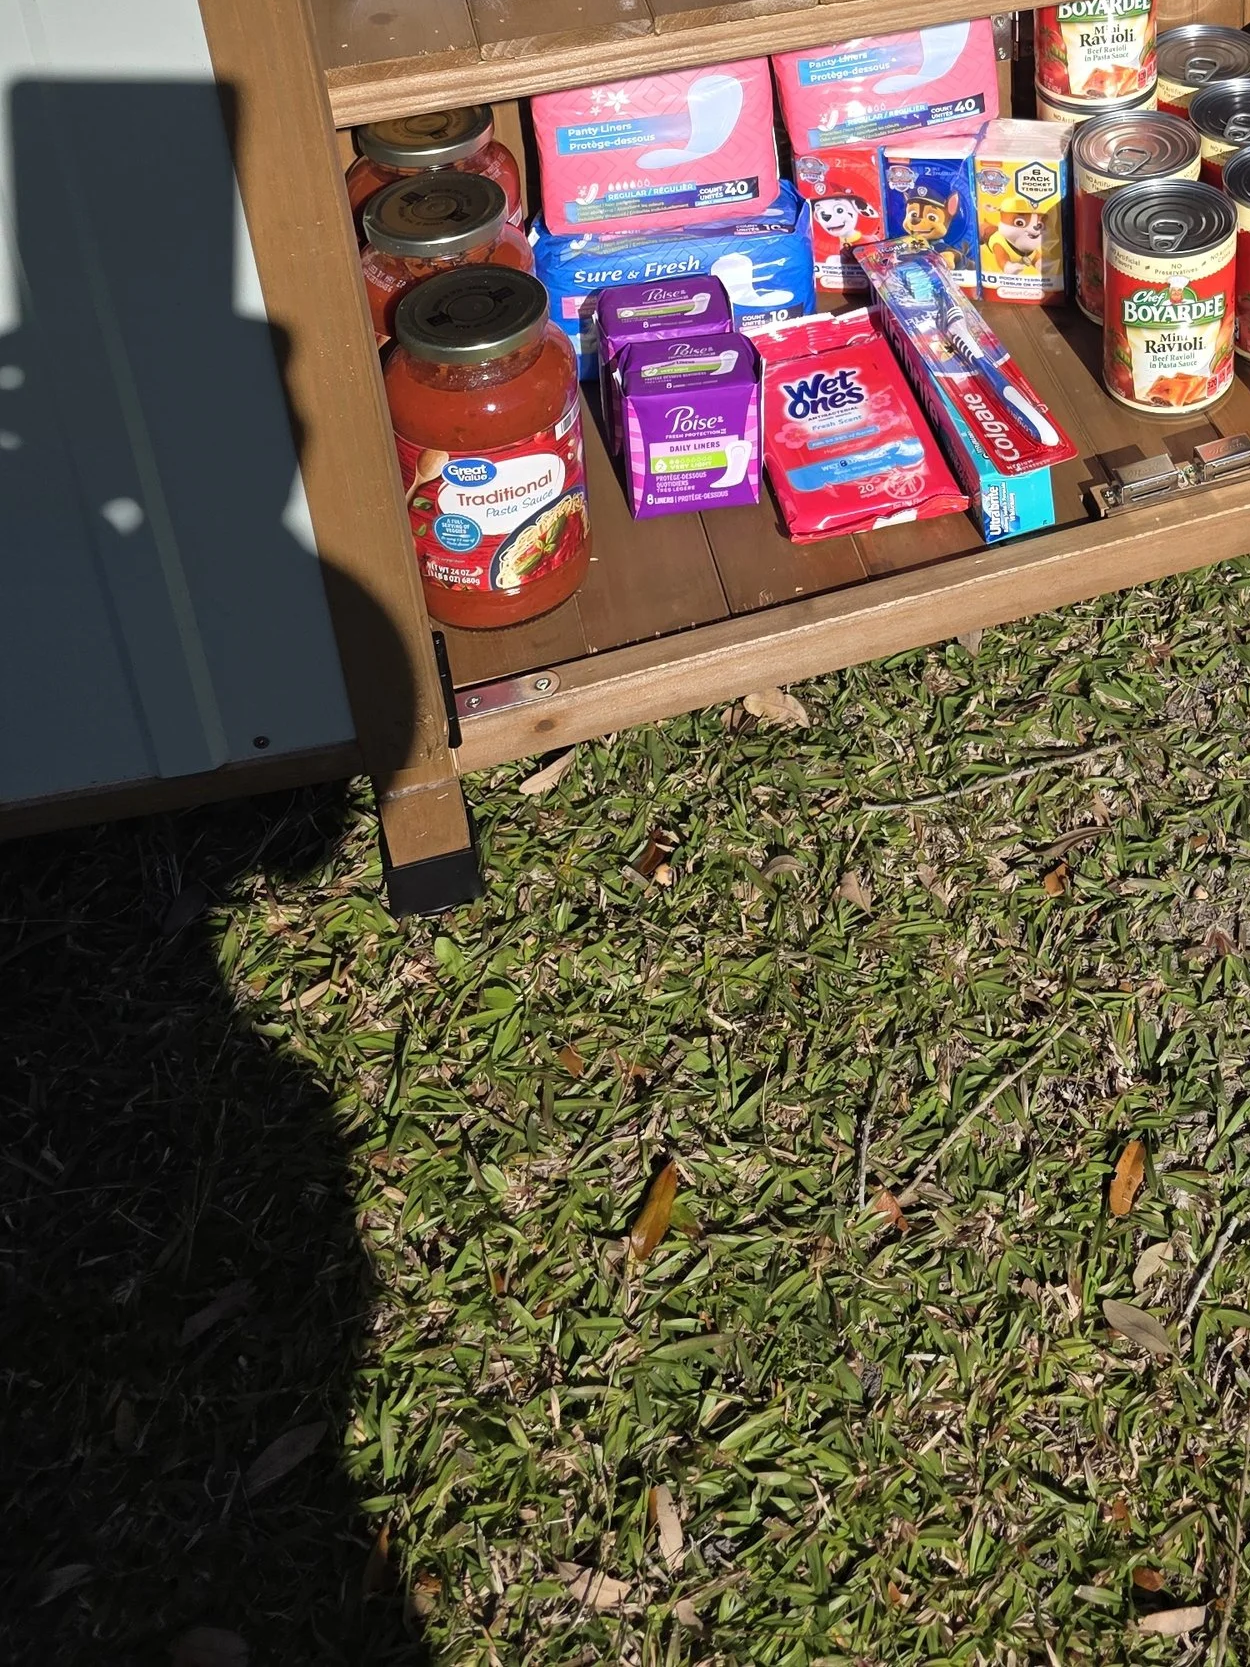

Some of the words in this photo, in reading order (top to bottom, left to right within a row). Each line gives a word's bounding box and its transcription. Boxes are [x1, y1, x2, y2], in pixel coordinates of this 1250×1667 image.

[567, 125, 598, 137] Panty
[601, 122, 632, 132] Liners
[699, 186, 722, 194] COUNT
[724, 180, 748, 195] 40
[573, 269, 622, 284] Sure
[627, 270, 640, 280] &
[644, 255, 701, 278] Fresh
[1133, 290, 1165, 306] Chef
[742, 314, 765, 322] COUNT
[769, 309, 789, 322] 10
[1124, 294, 1225, 324] BOYARDEE
[1145, 337, 1203, 354] Ravioli
[783, 370, 856, 400] Wet
[788, 386, 865, 419] Ones
[665, 406, 717, 433] Poise
[964, 393, 1020, 462] Colgate
[669, 445, 691, 453] DAILY
[694, 441, 720, 450] LINERS
[448, 464, 487, 475] Great
[457, 473, 487, 482] Value
[456, 470, 552, 506] Traditional
[858, 483, 874, 494] 20
[486, 505, 518, 518] Pasta
[522, 489, 553, 509] Sauce
[647, 494, 654, 505] 8
[989, 485, 1001, 536] Ultrabrite
